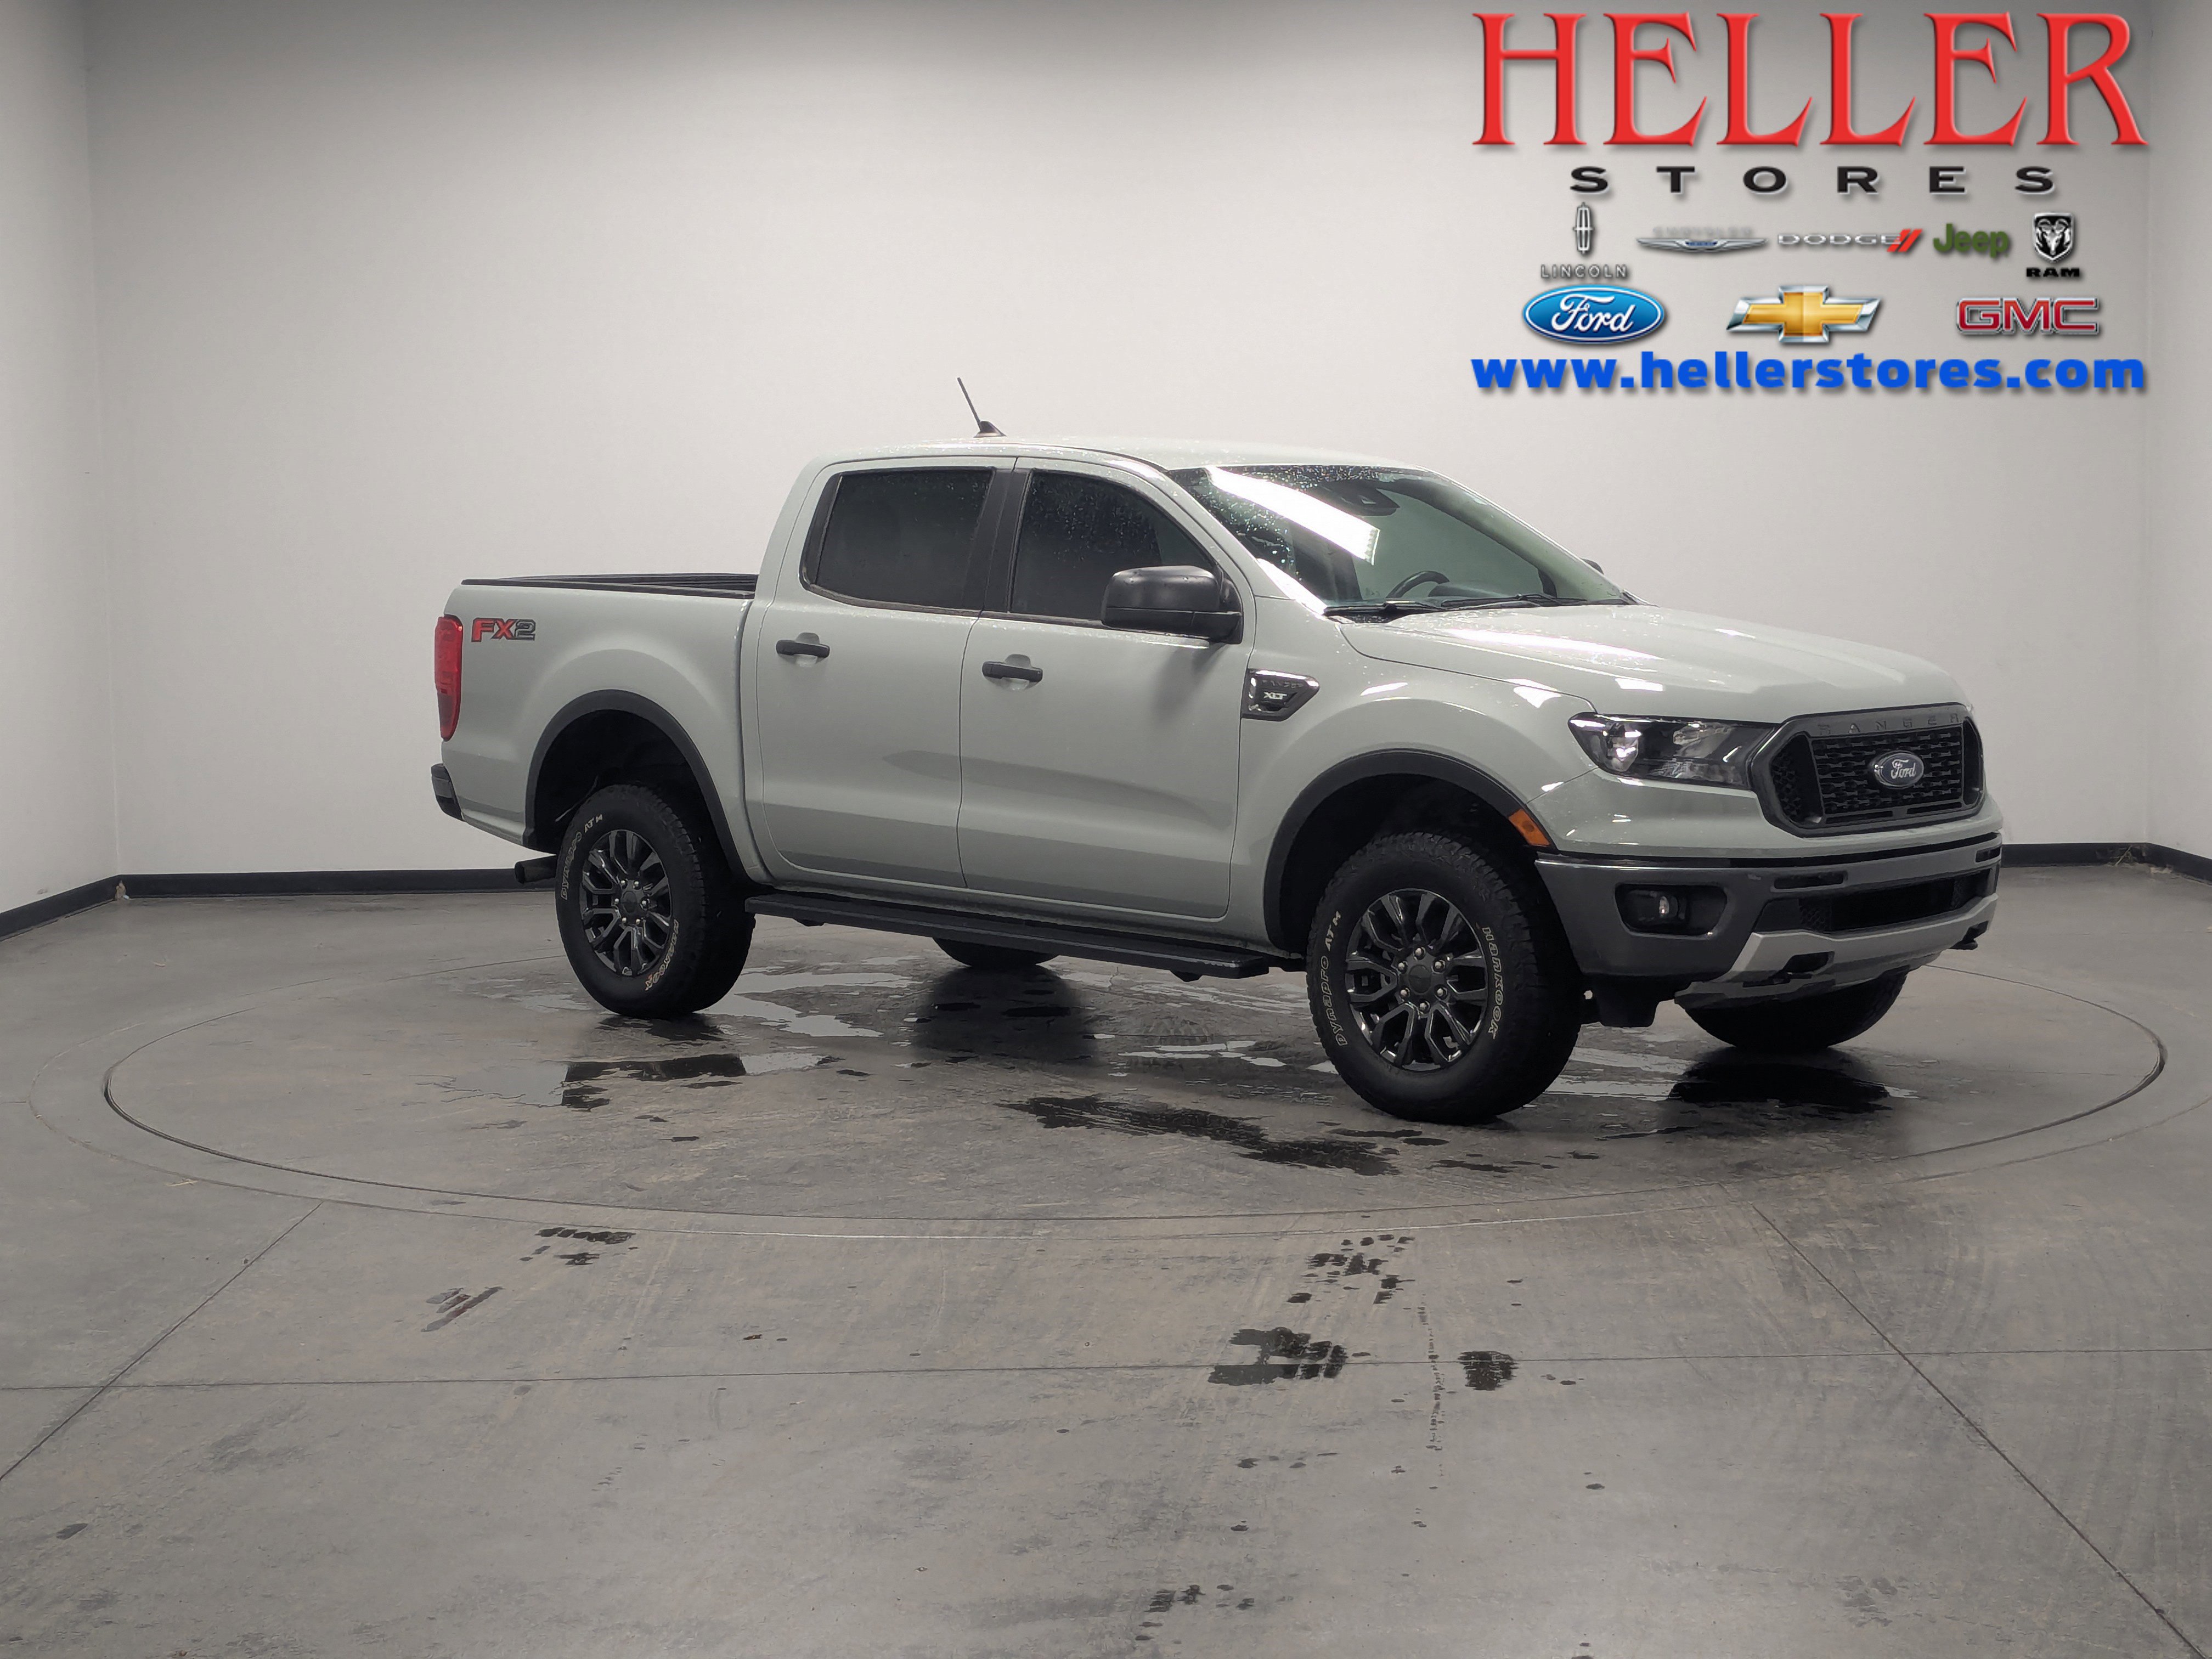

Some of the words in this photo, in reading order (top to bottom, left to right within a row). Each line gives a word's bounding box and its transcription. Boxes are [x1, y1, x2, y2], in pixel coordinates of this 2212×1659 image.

[471, 617, 537, 642] FX2
[1817, 713, 1960, 736] RANGER
[1891, 758, 1917, 780] Ford
